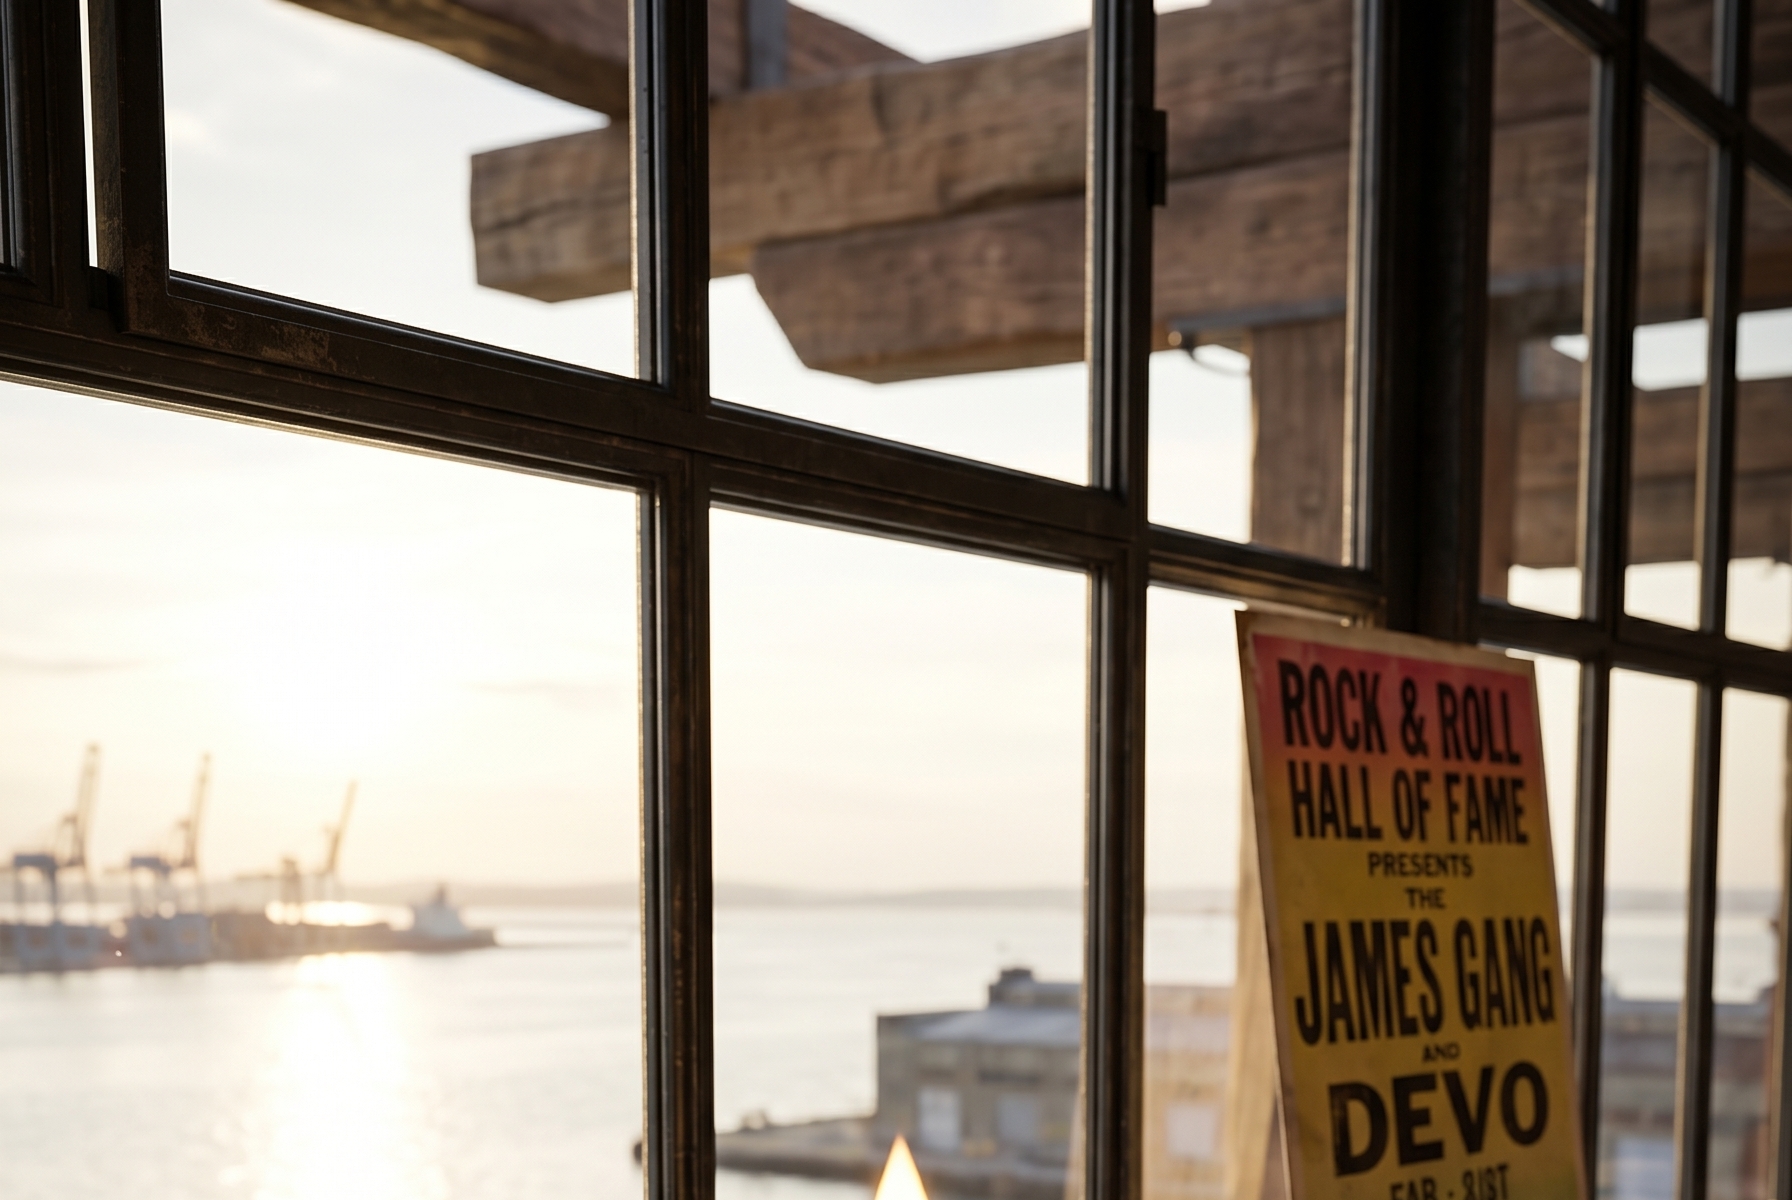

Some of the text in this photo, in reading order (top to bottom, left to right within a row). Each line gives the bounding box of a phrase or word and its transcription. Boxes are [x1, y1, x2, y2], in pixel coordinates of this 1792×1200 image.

[1278, 659, 1522, 765] ROCK & ROLL
[1287, 759, 1529, 845] HALL OF FAME
[1367, 852, 1473, 878] PRESENTS
[1404, 887, 1446, 909] THE
[1295, 916, 1556, 1046] JAMES GANG
[1422, 1043, 1460, 1063] AND
[1328, 1061, 1548, 1178] DEVO
